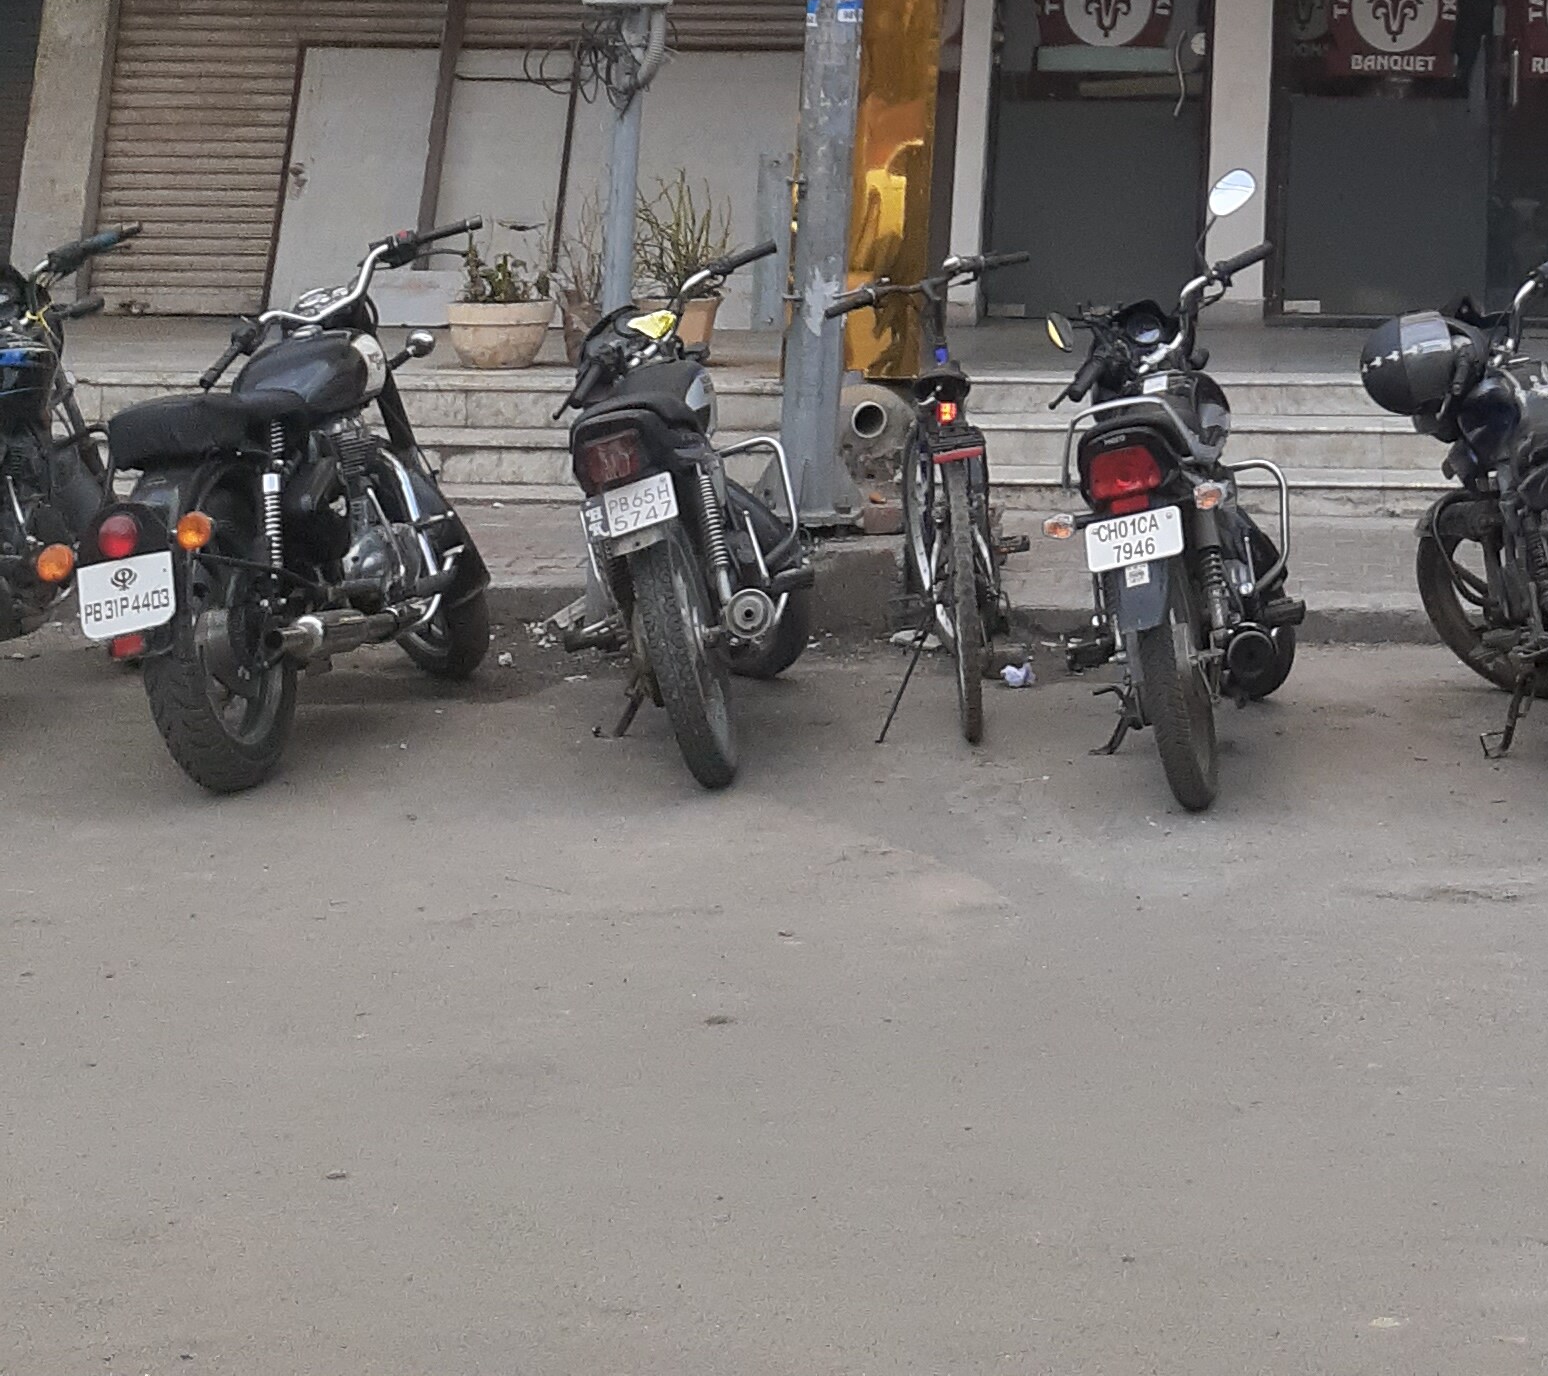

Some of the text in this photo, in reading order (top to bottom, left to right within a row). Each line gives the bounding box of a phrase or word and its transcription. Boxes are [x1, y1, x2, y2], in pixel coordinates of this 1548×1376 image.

[1351, 54, 1436, 72] BANQUET
[614, 500, 672, 531] 5747
[1097, 514, 1160, 543] CH01CA
[1113, 537, 1156, 563] 7946
